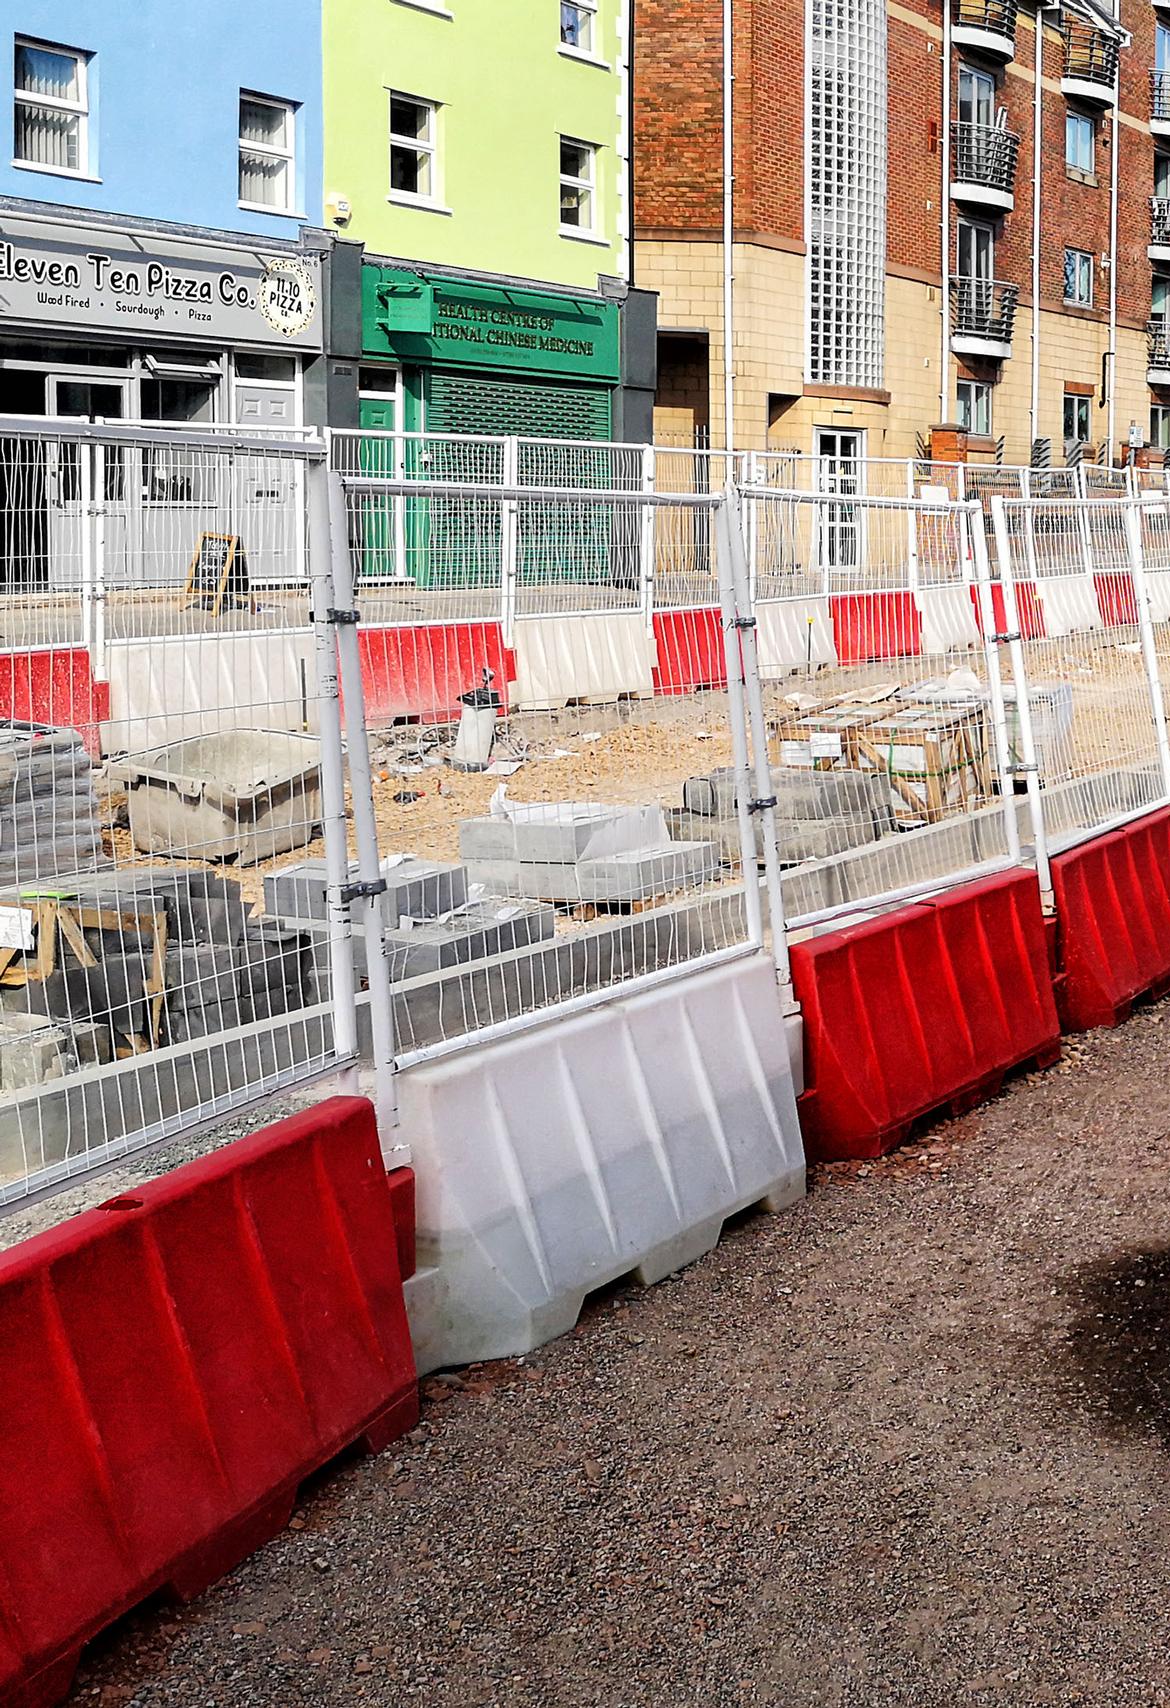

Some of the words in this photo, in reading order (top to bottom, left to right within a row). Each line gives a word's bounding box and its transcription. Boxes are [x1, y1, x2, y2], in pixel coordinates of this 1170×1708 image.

[87, 253, 139, 292] Ten
[147, 263, 212, 301] Pizza
[219, 273, 256, 306] Co.
[276, 277, 301, 298] 11.10
[37, 291, 62, 306] Wood
[65, 294, 90, 309] Fired
[115, 300, 165, 320] Sourdough
[188, 308, 212, 321] Pizza
[270, 291, 303, 315] PIZZA
[438, 302, 489, 323] HEALTH
[491, 309, 538, 330] CENTRE
[540, 316, 555, 331] OF
[487, 329, 537, 350] CHINESE
[538, 336, 594, 357] MEDICINE
